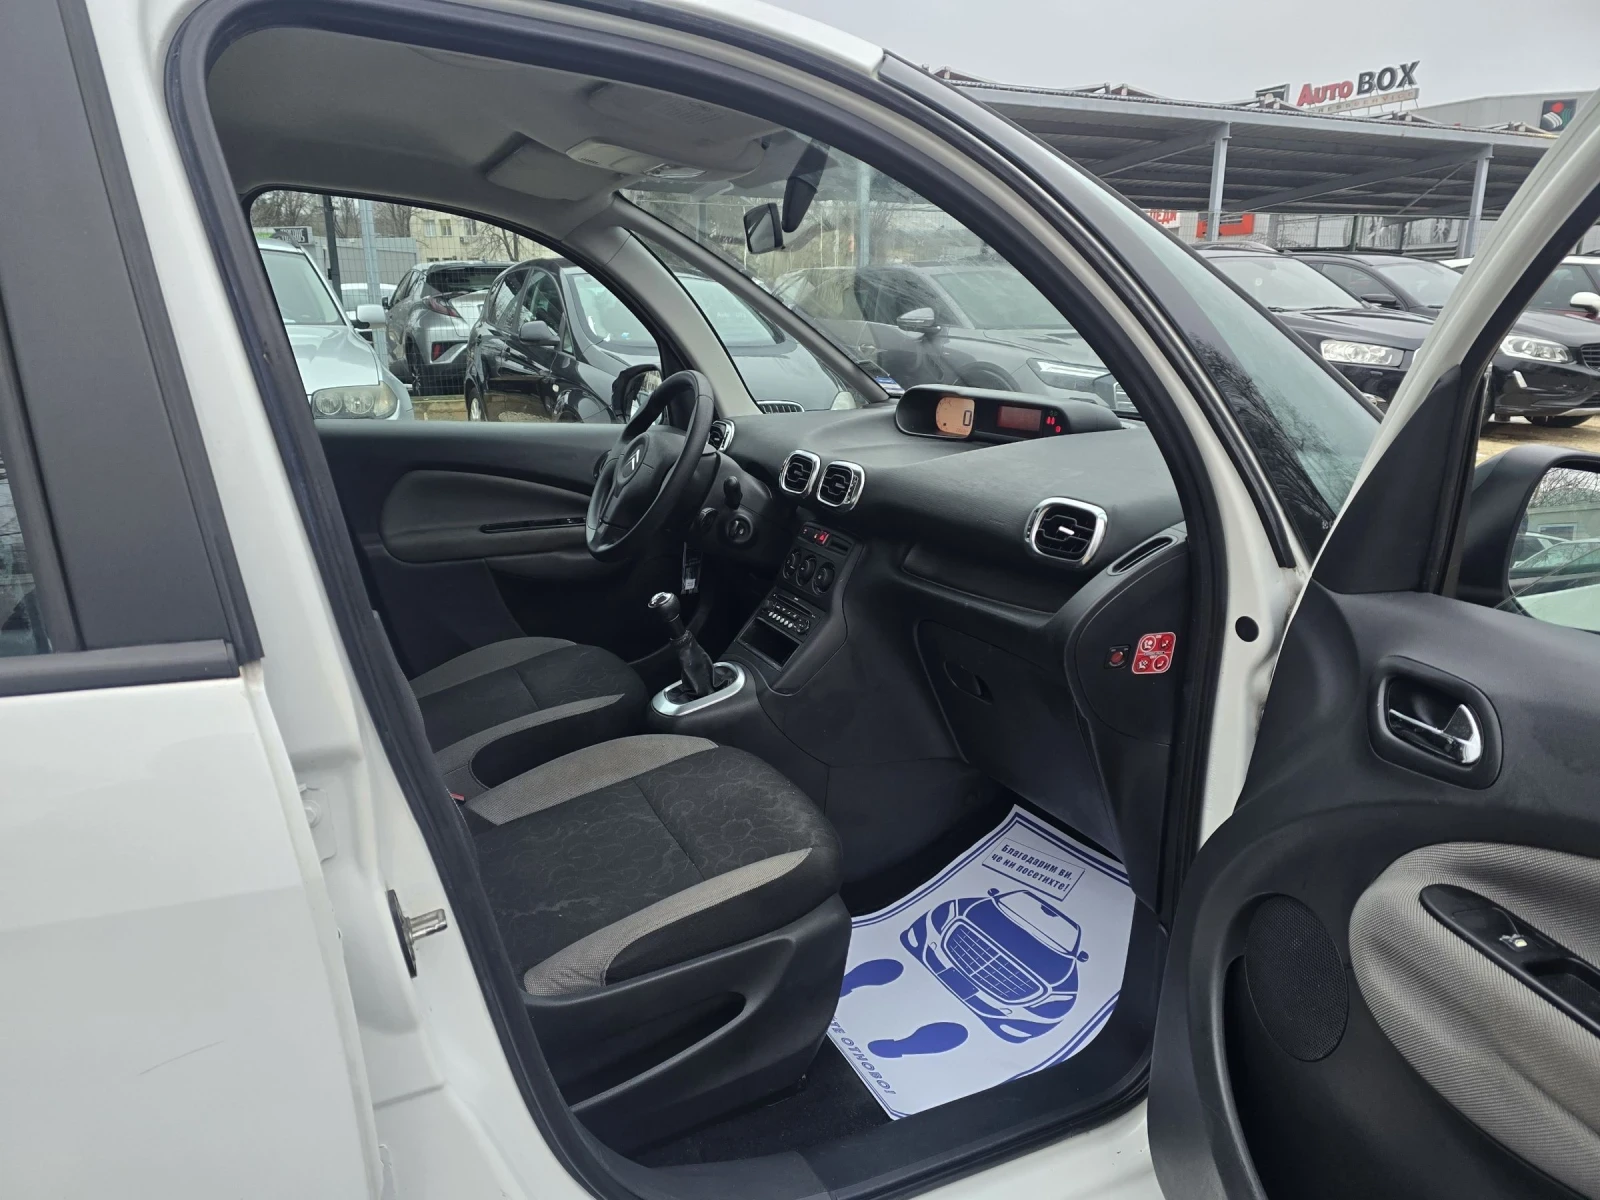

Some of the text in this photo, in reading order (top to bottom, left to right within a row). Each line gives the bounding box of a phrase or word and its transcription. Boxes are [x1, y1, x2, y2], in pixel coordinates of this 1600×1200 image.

[1357, 60, 1421, 95] BOX
[991, 853, 1071, 892] че ни посетихте!
[1001, 844, 1073, 880] Благодарим ви,
[841, 1037, 896, 1095] ОТНОВО!
